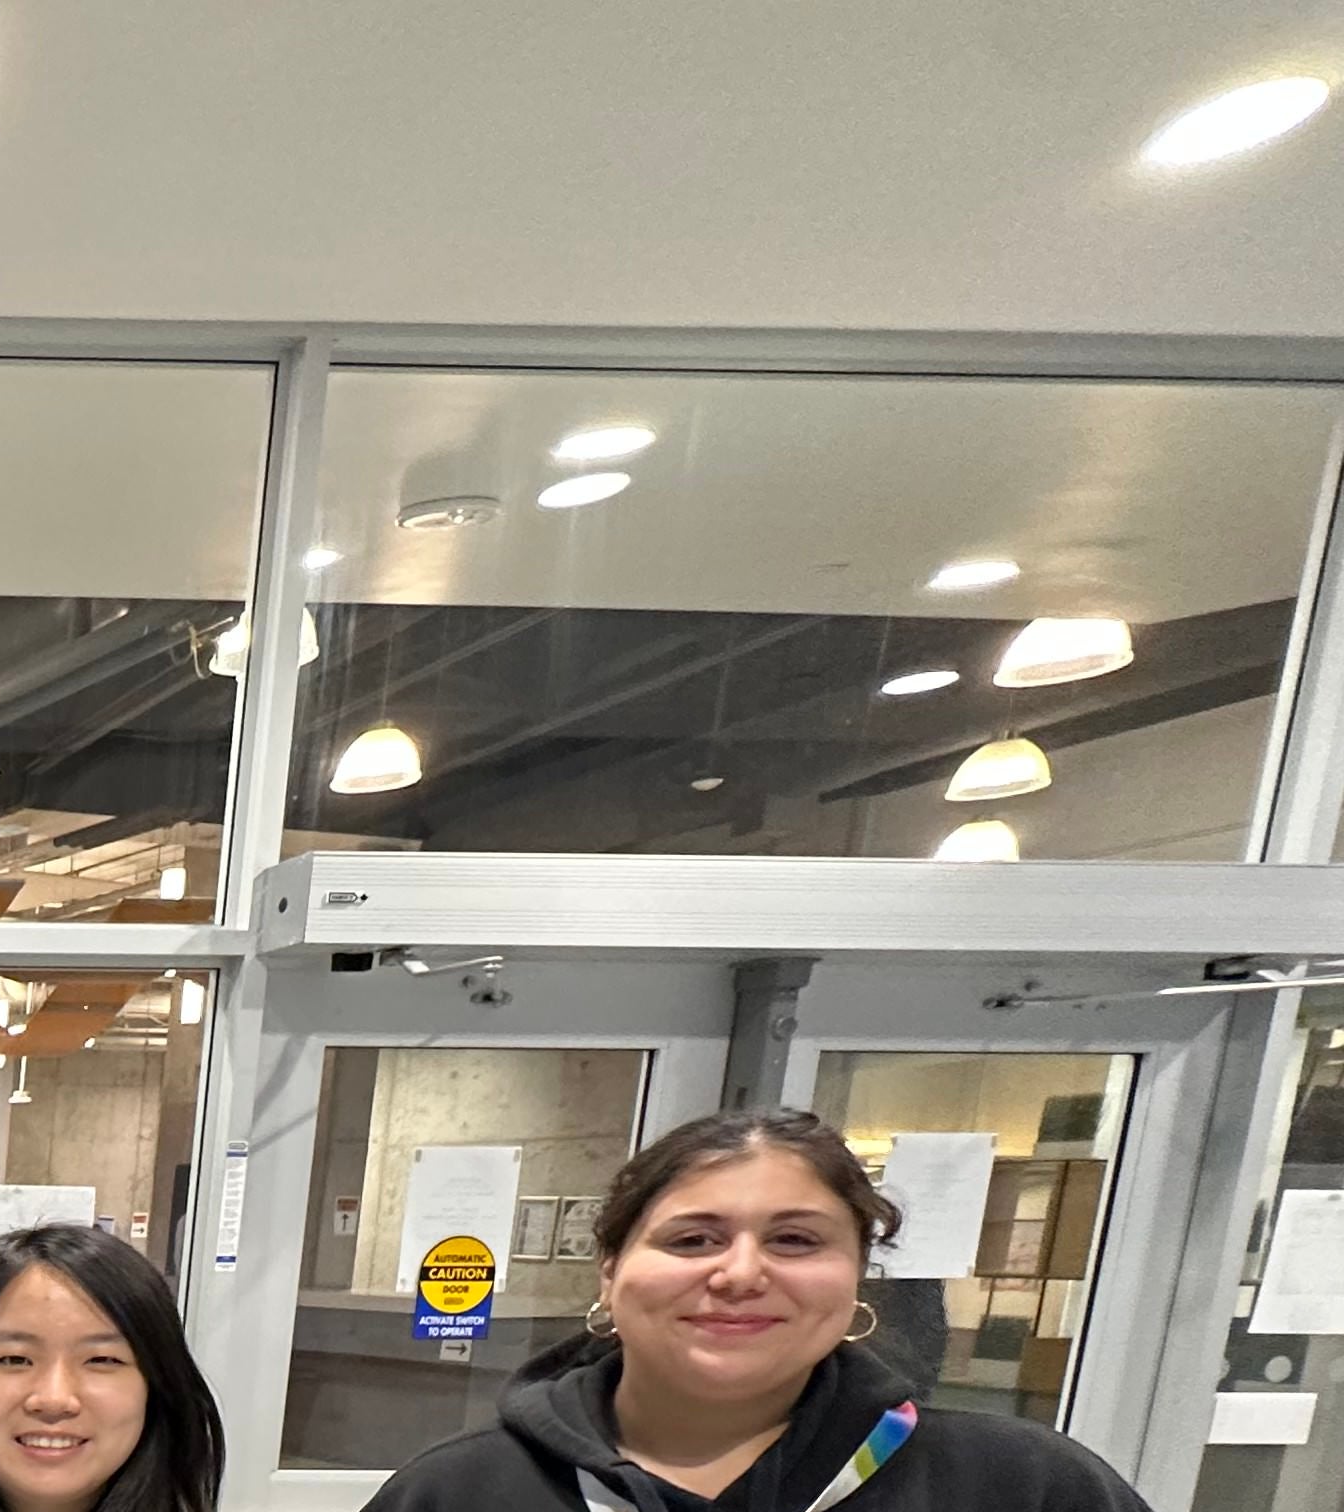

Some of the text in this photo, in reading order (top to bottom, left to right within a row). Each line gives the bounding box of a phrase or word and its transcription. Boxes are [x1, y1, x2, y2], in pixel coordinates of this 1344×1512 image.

[434, 1254, 487, 1263] AUTOMATIC
[428, 1267, 488, 1280] CAUTION
[442, 1285, 470, 1293] DOOR
[419, 1316, 485, 1325] ACTIVATE SWITCH
[428, 1327, 473, 1336] TO OPERATE
